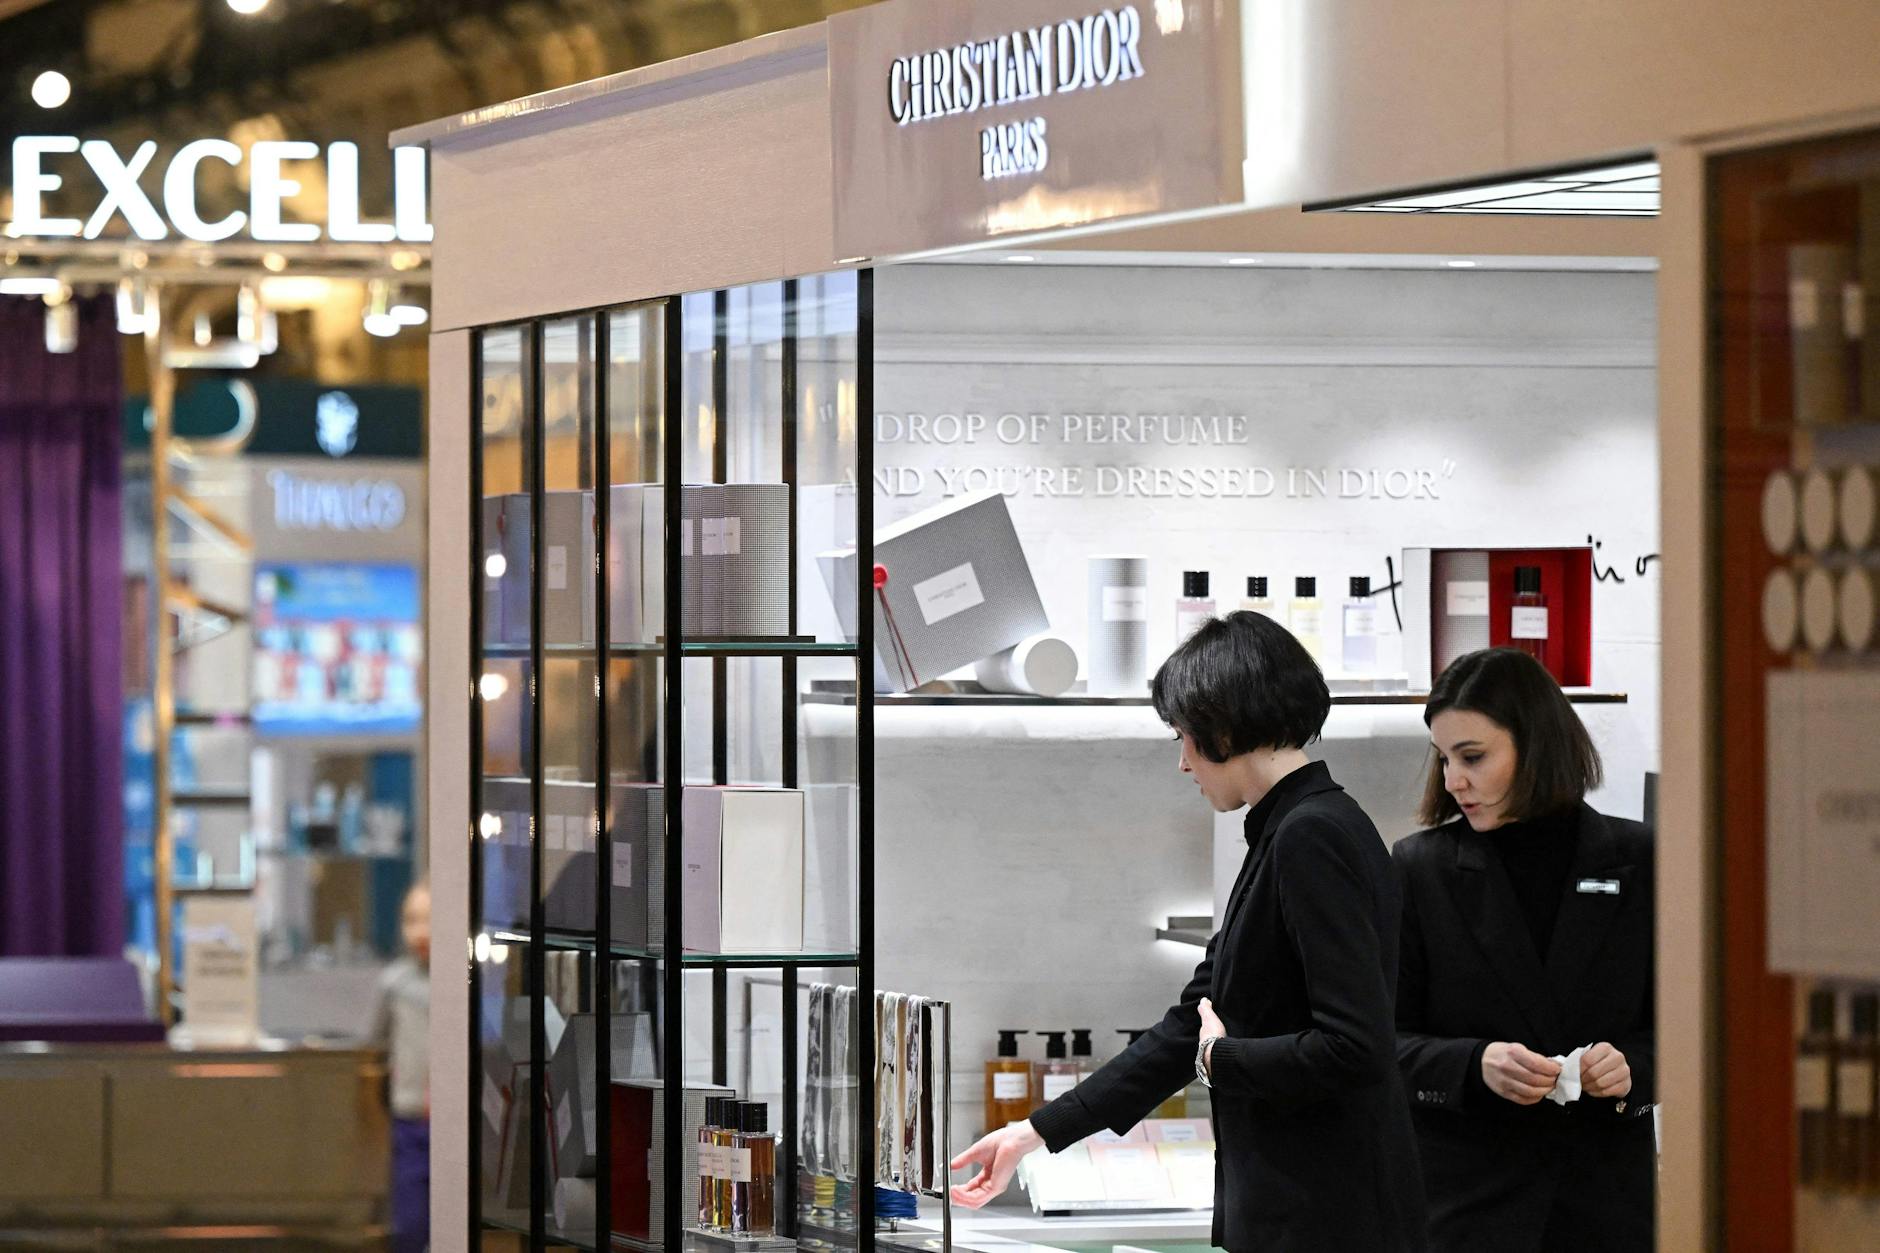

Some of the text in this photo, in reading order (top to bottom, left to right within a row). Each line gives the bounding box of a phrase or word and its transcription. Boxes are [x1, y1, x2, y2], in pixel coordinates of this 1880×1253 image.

[888, 5, 1145, 126] CHRISTIAN DIOR
[979, 116, 1047, 181] PARIS
[875, 412, 988, 445] DROP
[996, 412, 1051, 445] OF
[1060, 412, 1249, 446] PERFUME
[1095, 464, 1275, 498] DRESSED
[1286, 466, 1328, 499] IN
